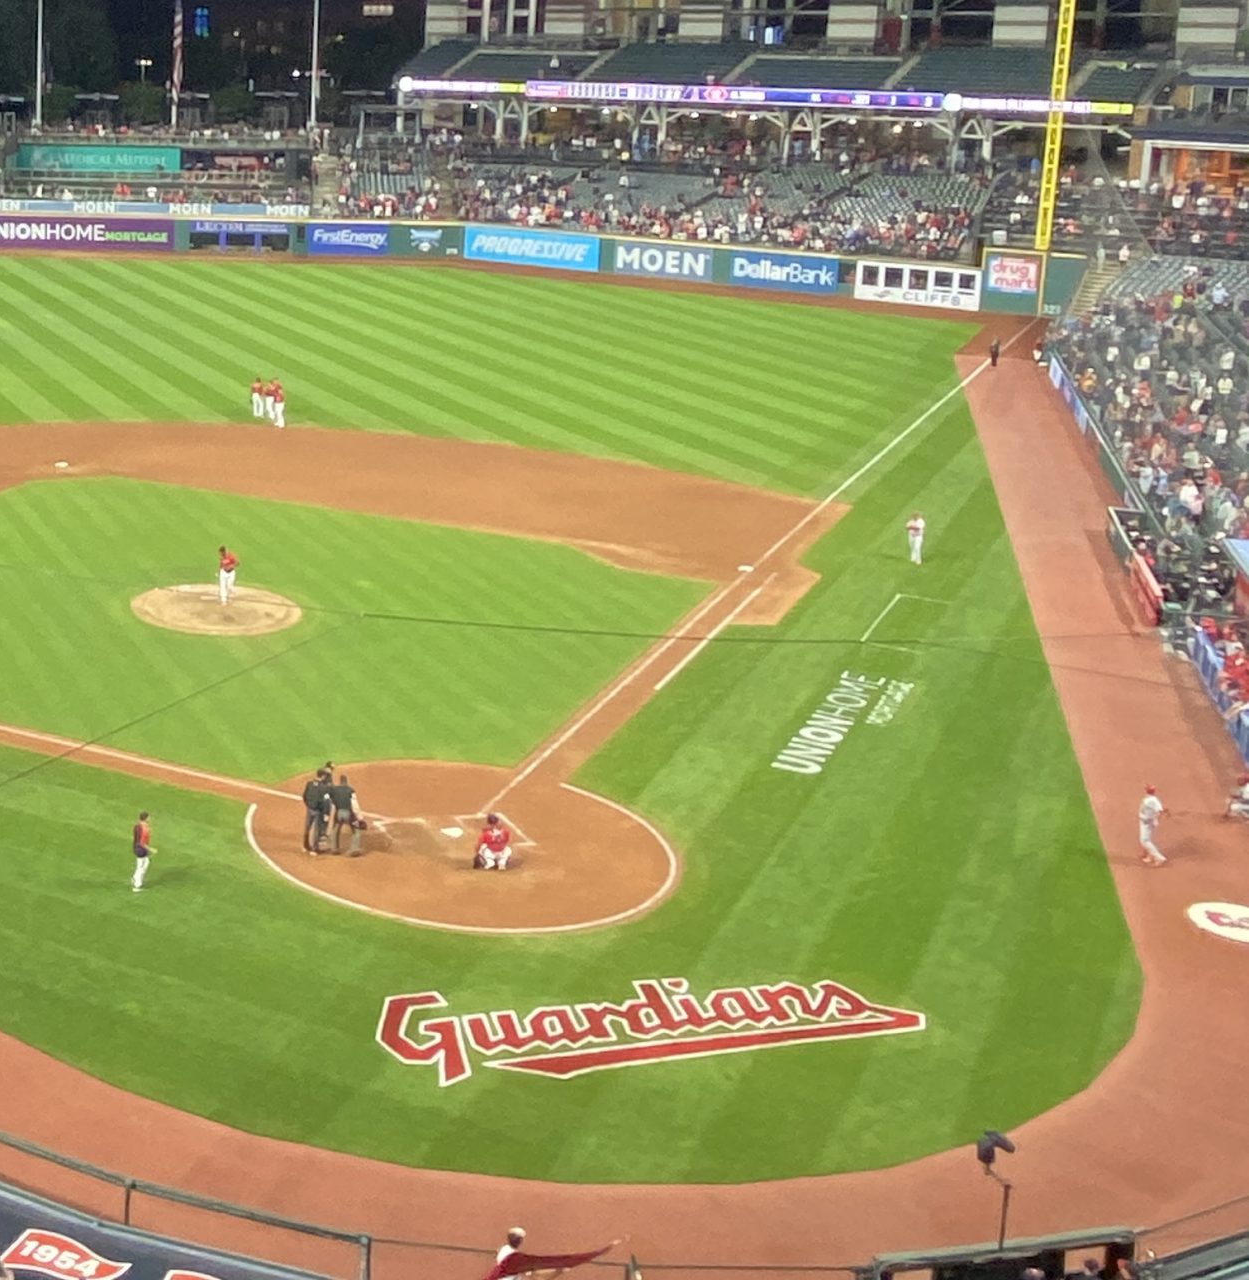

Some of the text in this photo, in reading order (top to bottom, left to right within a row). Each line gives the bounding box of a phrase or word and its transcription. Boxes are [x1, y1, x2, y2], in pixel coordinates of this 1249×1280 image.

[58, 153, 167, 167] MEDICAL MUTUAL
[73, 201, 116, 213] MOEN
[168, 203, 211, 215] MOEN
[266, 205, 309, 216] MOEN
[105, 231, 168, 243] MORTGAGE
[312, 228, 388, 249] FirstEnergy
[471, 234, 590, 262] PROGRESSIVE
[616, 245, 706, 277] MOEN
[992, 257, 1029, 279] drug
[733, 256, 836, 288] DollarBank
[994, 276, 1035, 289] mart
[901, 290, 962, 307] CLIFFS
[771, 670, 886, 775] UNIONHOME
[375, 977, 926, 1088] Guardians
[17, 1236, 102, 1278] 1954
